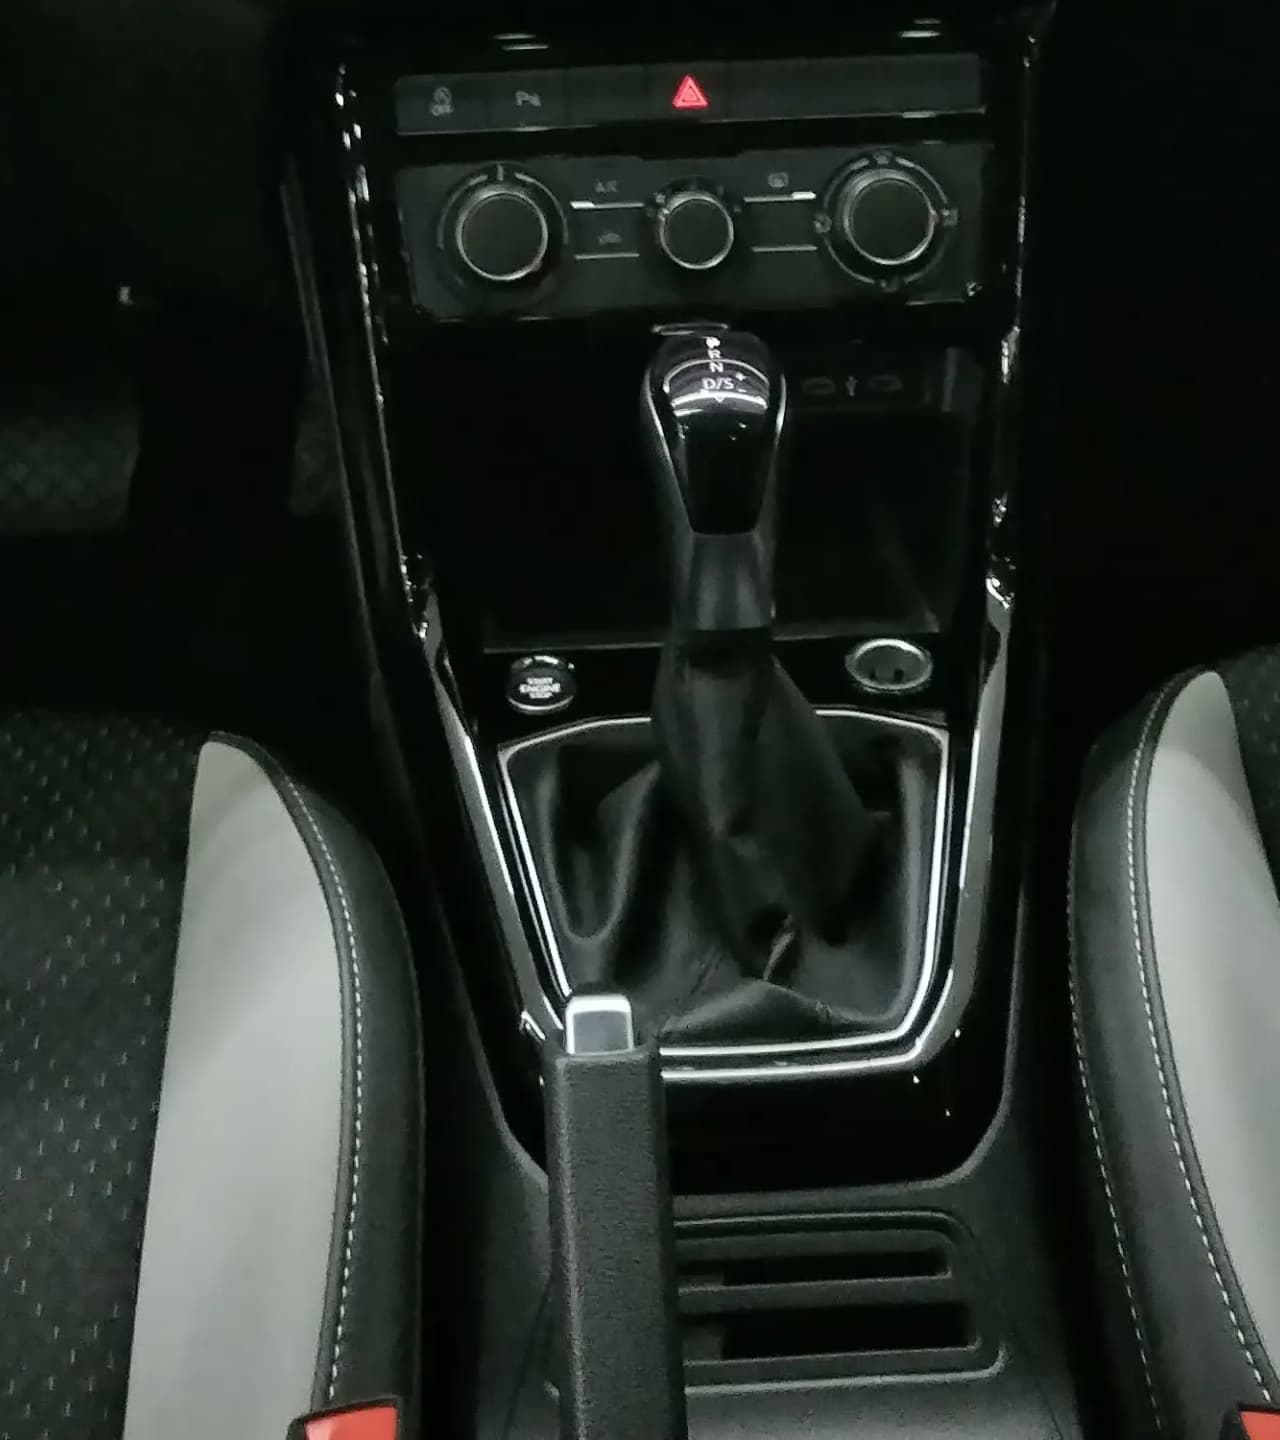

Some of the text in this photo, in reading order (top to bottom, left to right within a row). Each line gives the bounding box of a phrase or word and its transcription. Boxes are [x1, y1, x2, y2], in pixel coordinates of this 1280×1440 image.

[707, 349, 721, 360] R
[709, 361, 724, 373] N
[702, 377, 735, 390] D/S
[519, 683, 561, 693] ENGINE
